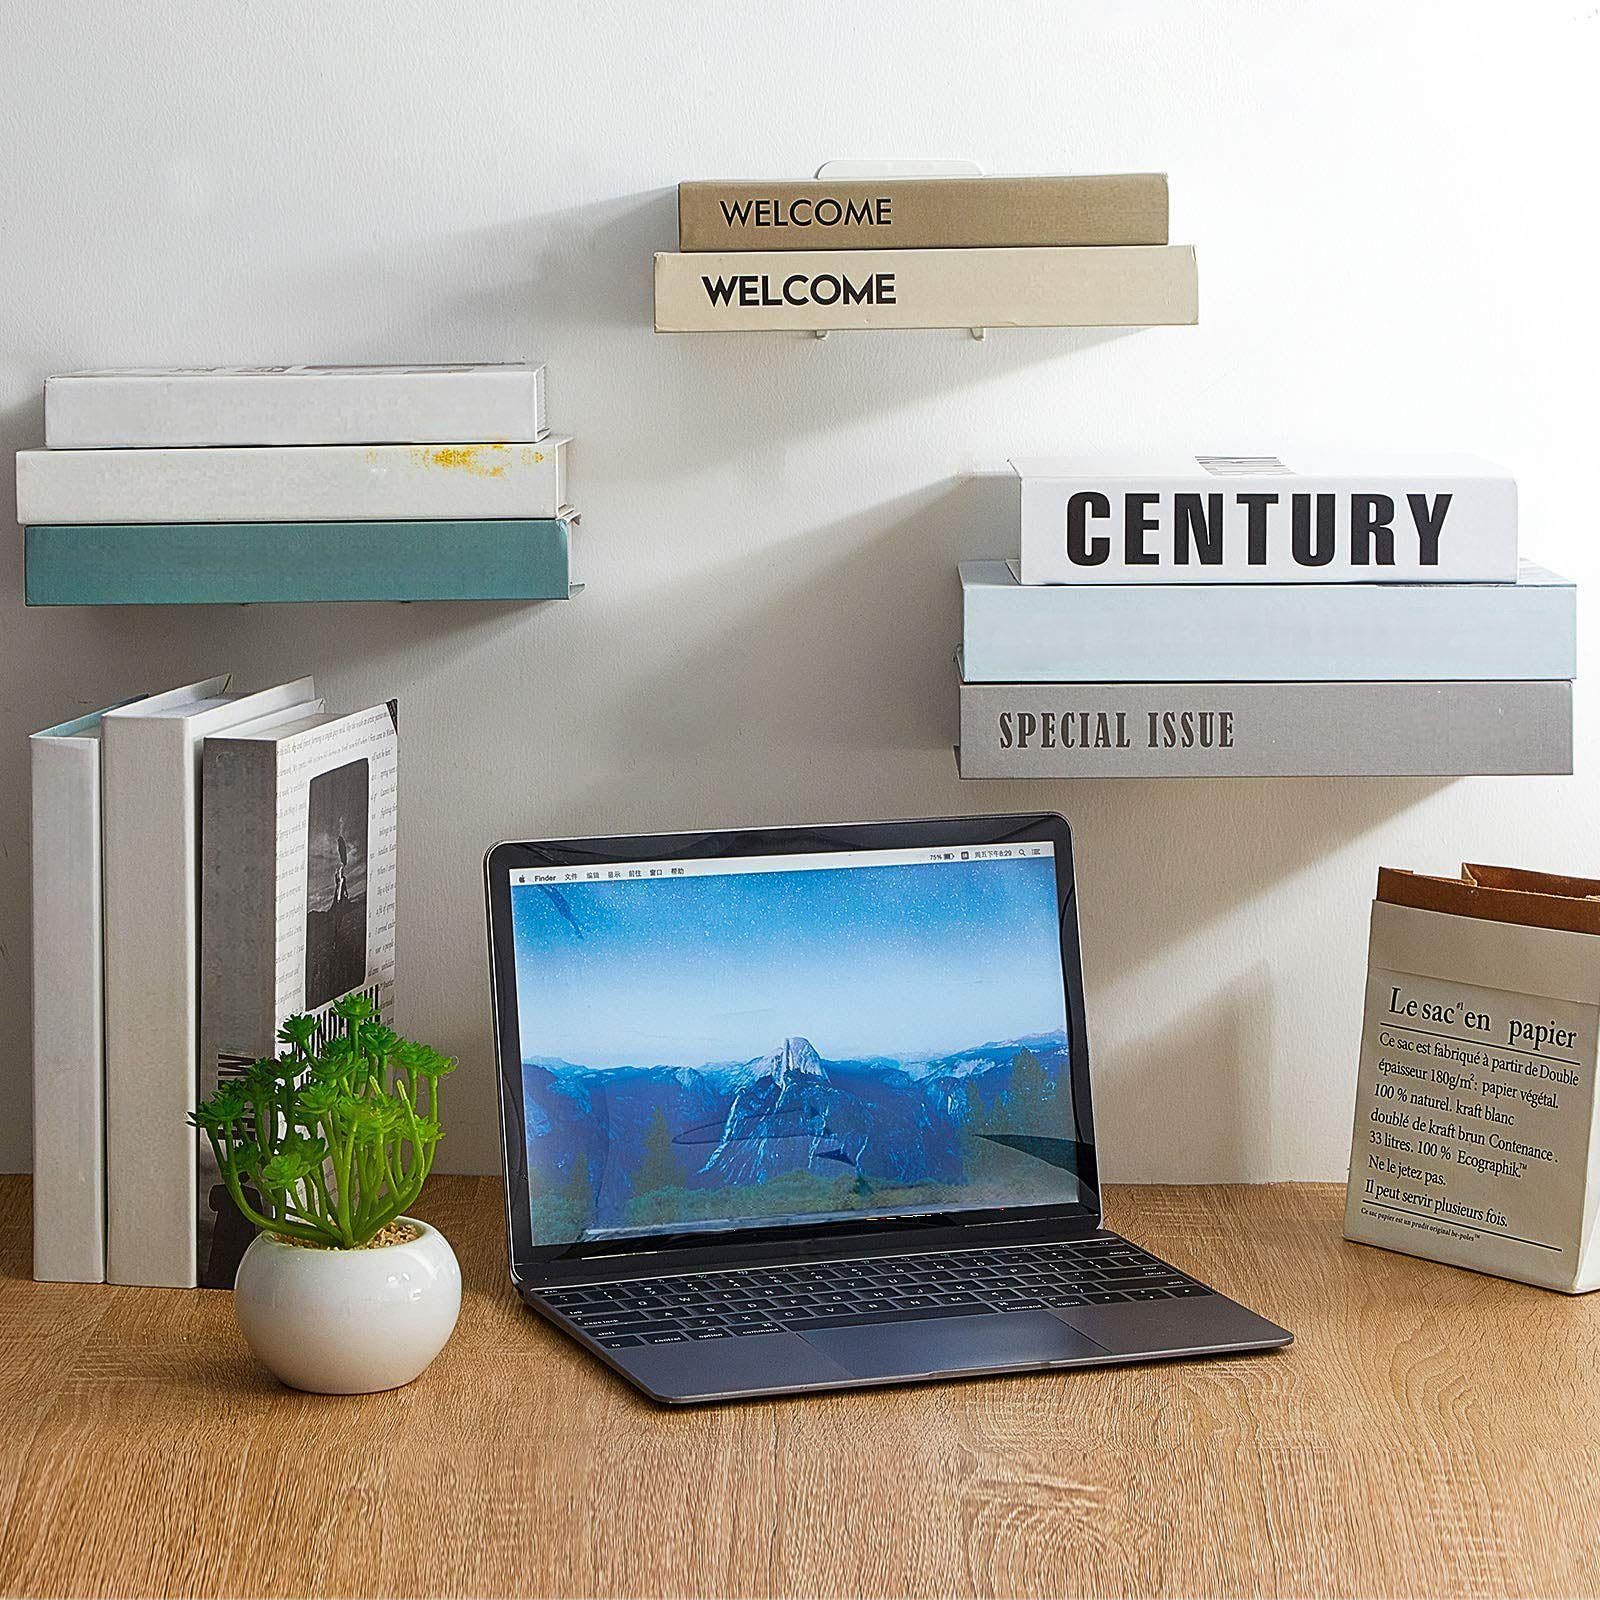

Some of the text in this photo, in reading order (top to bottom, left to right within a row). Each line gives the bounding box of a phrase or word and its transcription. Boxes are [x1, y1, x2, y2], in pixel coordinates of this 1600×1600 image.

[719, 198, 892, 228] WELCOME
[701, 273, 897, 307] WELCOME
[1066, 491, 1453, 567] CENTURY
[999, 711, 1235, 749] SPECIAL ISSUE
[1388, 986, 1418, 1017] Le
[1464, 1011, 1491, 1032] en
[1507, 1020, 1577, 1051] papier
[1379, 1031, 1579, 1086] Ce sac est fabriqué à partir de Double
[1378, 1058, 1428, 1080] épaisseur
[1481, 1081, 1518, 1099] papier
[1520, 1089, 1559, 1109] végétal.
[1374, 1084, 1515, 1126] 100 % naturel. kraft blanc
[1369, 1130, 1383, 1145] 33
[1384, 1131, 1414, 1153] litres.
[1417, 1140, 1438, 1157] 100
[1440, 1146, 1451, 1161] %
[1370, 1107, 1410, 1129] doublé
[1412, 1116, 1427, 1132] de
[1428, 1118, 1457, 1139] kraft
[1458, 1125, 1485, 1146] brun
[1368, 1154, 1447, 1187] Ne le jetez pas.
[1364, 1179, 1508, 1228] Il peut servir plusieurs fois.
[1378, 1213, 1395, 1222] papier
[1430, 1225, 1452, 1237] original
